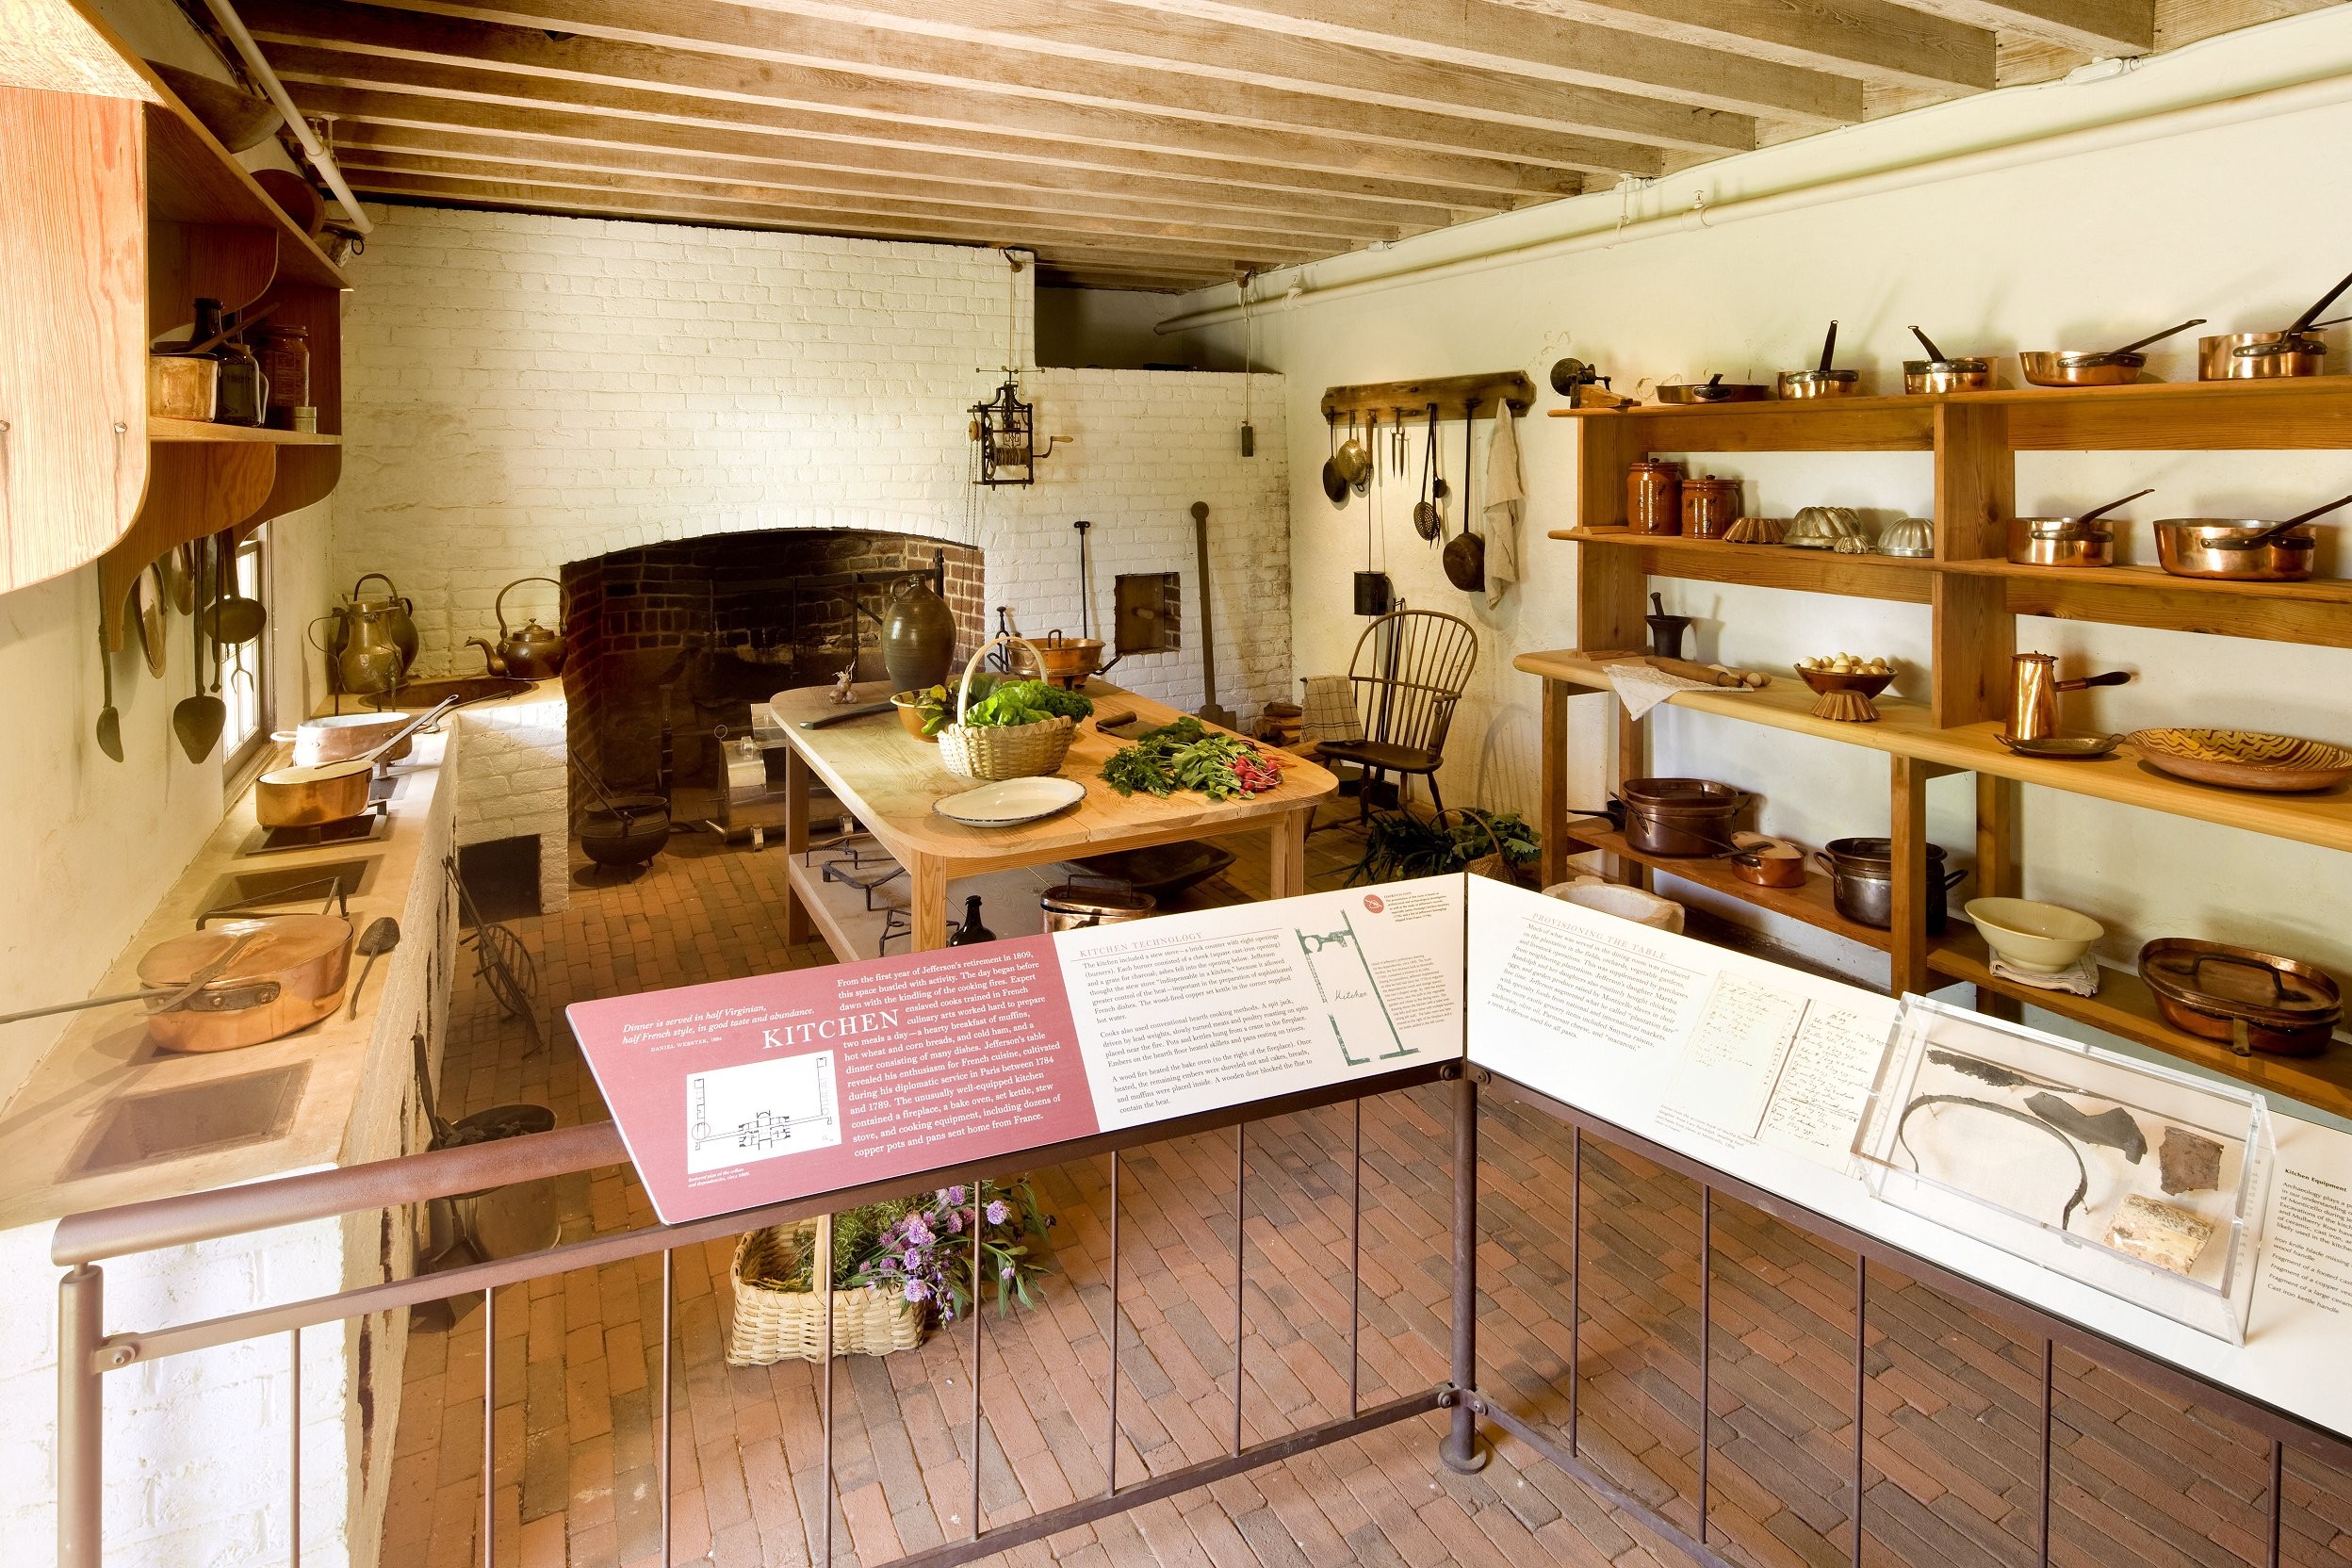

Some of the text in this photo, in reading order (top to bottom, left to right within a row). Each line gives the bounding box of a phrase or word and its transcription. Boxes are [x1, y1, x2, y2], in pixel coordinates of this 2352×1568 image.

[1079, 932, 1201, 956] KITCHEN TECHNOLOGY
[1532, 912, 1666, 959] PROVISIONING THE TABLE
[837, 978, 858, 987] From
[874, 972, 892, 981] first
[893, 971, 910, 980] year
[912, 967, 920, 975] of
[922, 961, 961, 973] Jefferson's
[963, 956, 1002, 968] retirement
[1013, 951, 1034, 960] 1809,
[838, 961, 1039, 999] this space bustled with activity. The day began before
[839, 1003, 861, 1011] dawn
[863, 997, 882, 1006] with
[884, 995, 897, 1004] the
[898, 990, 932, 1001] kindling
[933, 987, 942, 995] of
[942, 986, 956, 994] the
[957, 982, 988, 992] cooking
[1010, 973, 1036, 984] Expert
[905, 1000, 939, 1013] enslaved
[939, 997, 962, 1006] cooks
[963, 991, 991, 1003] trained
[1002, 986, 1028, 996] French
[622, 1022, 654, 1033] Dinner
[665, 1014, 693, 1025] served
[705, 1009, 724, 1020] half
[725, 1005, 766, 1016] Virginian,
[622, 1034, 642, 1044] half
[642, 1029, 671, 1040] French
[673, 1025, 694, 1037] style,
[708, 1020, 728, 1032] good
[730, 1018, 750, 1026] taste
[751, 1013, 768, 1023] and
[769, 1008, 814, 1021] abundance.
[906, 1014, 939, 1024] culinary
[957, 1004, 987, 1016] worked
[987, 1001, 1005, 1011] hard
[1016, 996, 1045, 1008] prepare
[1134, 1023, 1149, 1032] used
[1150, 1017, 1188, 1029] conventional
[1188, 1013, 1208, 1021] hearth
[1233, 1004, 1260, 1014] methods.
[1280, 998, 1294, 1006] jack,
[762, 1008, 898, 1048] KITCHEN
[844, 1053, 858, 1061] hot
[860, 1048, 886, 1058] wheat
[888, 1043, 904, 1054] and
[905, 1042, 923, 1051] corn
[925, 1036, 955, 1047] breads,
[956, 1031, 972, 1041] and
[973, 1028, 990, 1038] cold
[990, 1027, 1011, 1036] ham,
[1013, 1021, 1028, 1032] and
[860, 1035, 885, 1045] meals
[893, 1030, 922, 1040] day—a
[923, 1025, 949, 1034] hearty
[950, 1018, 987, 1029] breakfast
[988, 1015, 997, 1023] of
[998, 1011, 1030, 1021] muffins,
[1105, 1049, 1125, 1059] placed
[1282, 1016, 1307, 1024] fireplace.
[845, 1032, 1046, 1074] dinner consisting of many dishes. Jefferson's table
[850, 1072, 1044, 1115] and 1789. The unusually well-equipped kitchen
[2282, 1182, 2321, 1198] Archaeology
[2323, 1196, 2340, 1204] plays
[2284, 1168, 2346, 1192] Kitchen Equipment
[2292, 1213, 2320, 1227] Mulberry
[2322, 1223, 2337, 1232] Row
[2273, 1243, 2315, 1261] wood handle
[2274, 1235, 2349, 1267] Iron knife blade missing
[2267, 1283, 2340, 1314] Cast iron kettle handle
